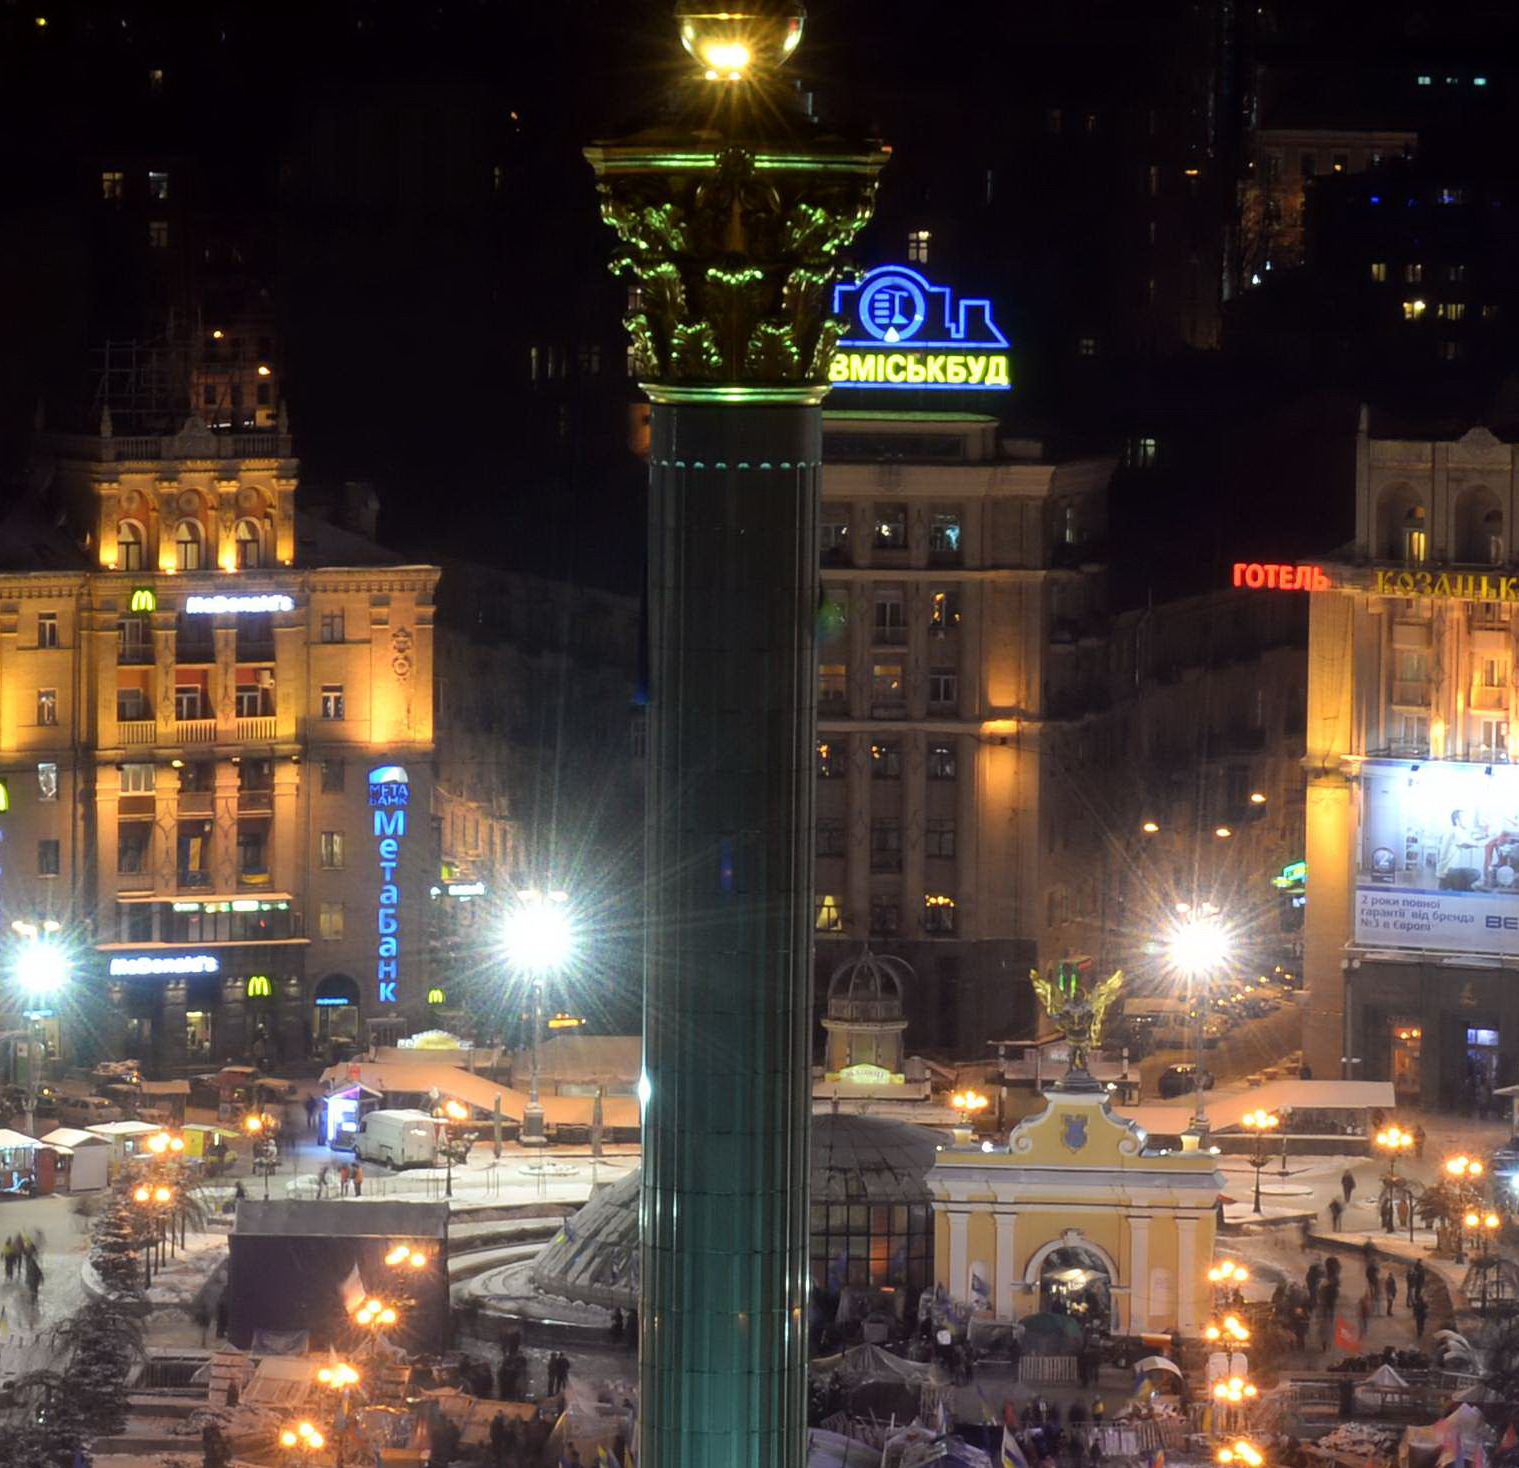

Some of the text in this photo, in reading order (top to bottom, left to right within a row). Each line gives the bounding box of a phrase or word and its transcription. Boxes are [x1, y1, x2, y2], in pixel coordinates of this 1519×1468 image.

[1233, 563, 1330, 591] ГОТЕЛЬ
[1371, 897, 1400, 907] роки
[109, 955, 219, 976] McDonald's
